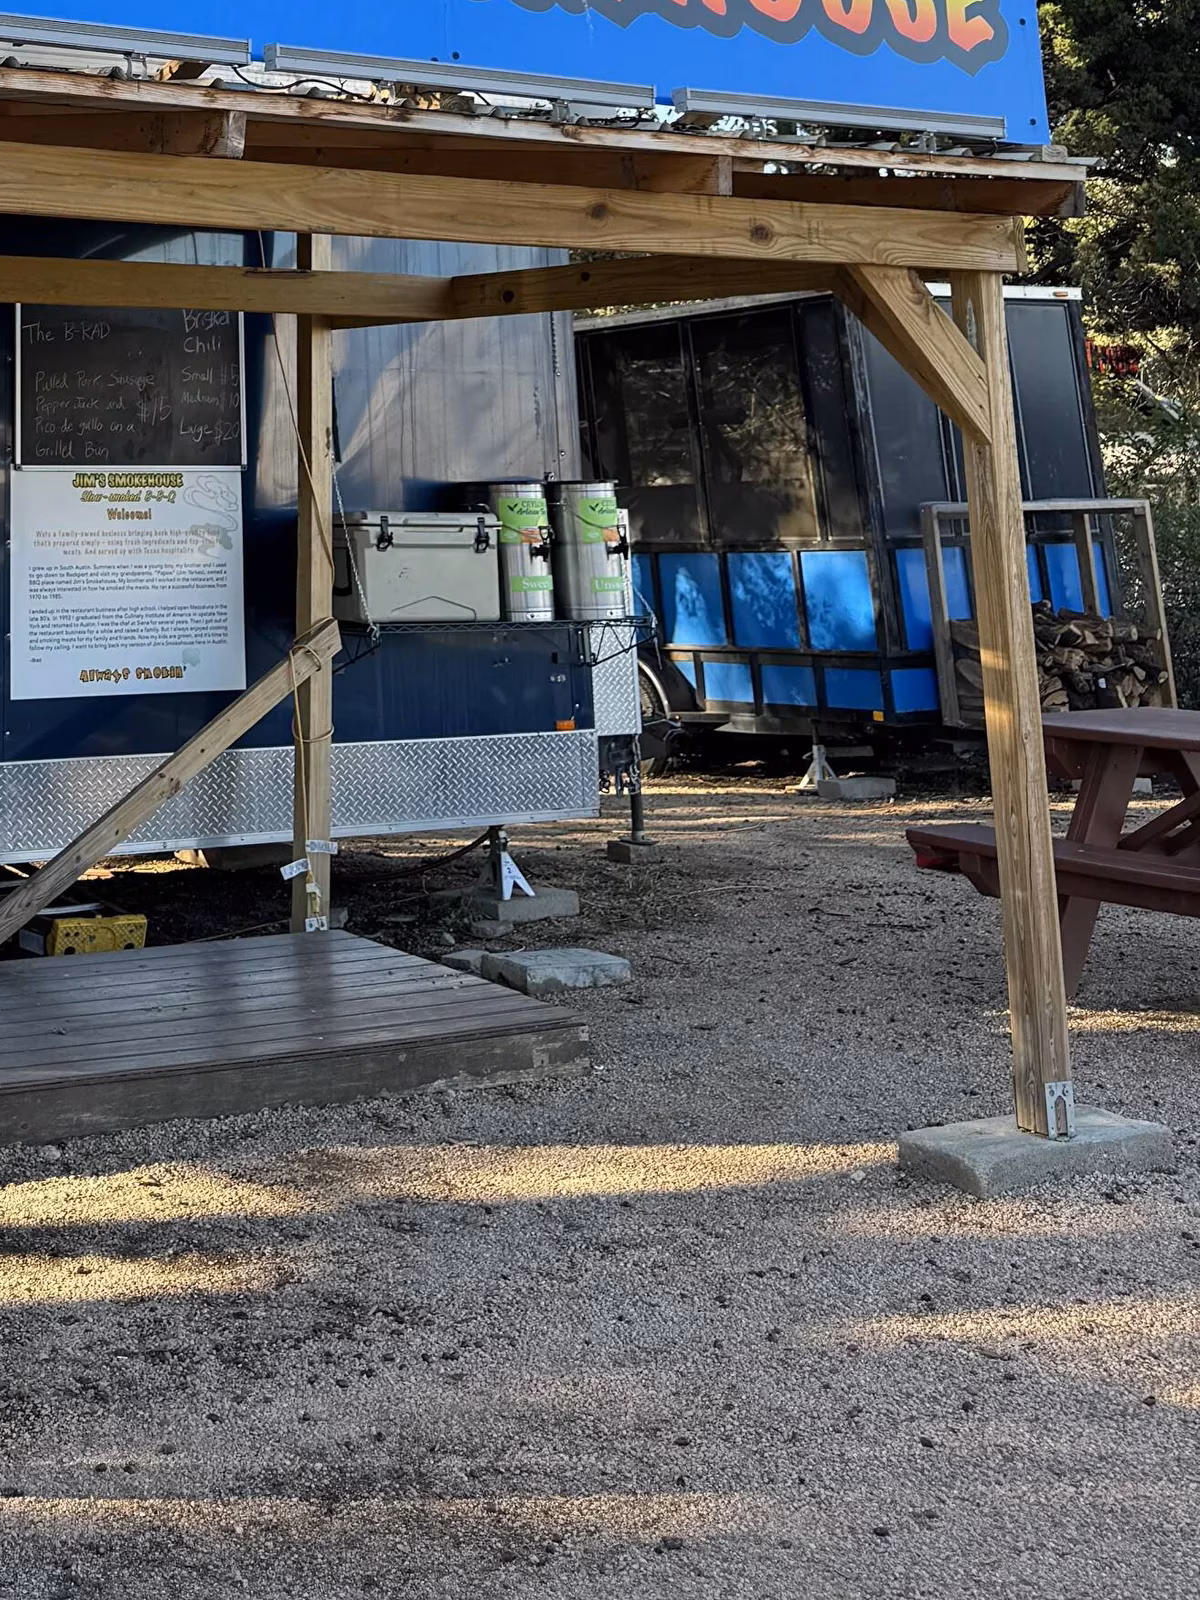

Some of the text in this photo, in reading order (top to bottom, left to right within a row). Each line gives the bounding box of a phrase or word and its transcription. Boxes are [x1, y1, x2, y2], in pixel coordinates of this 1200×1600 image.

[22, 321, 55, 344] The
[184, 336, 221, 353] Chili
[36, 371, 69, 392] Pulled
[76, 370, 102, 389] Pork
[182, 365, 213, 385] Small
[34, 416, 56, 434] Pico
[76, 418, 103, 436] gallo
[180, 416, 213, 443] Large
[36, 440, 109, 460] Grilled Bun
[72, 472, 184, 489] JIM'S SMOKEHOUSE
[106, 508, 152, 521] Welcome!
